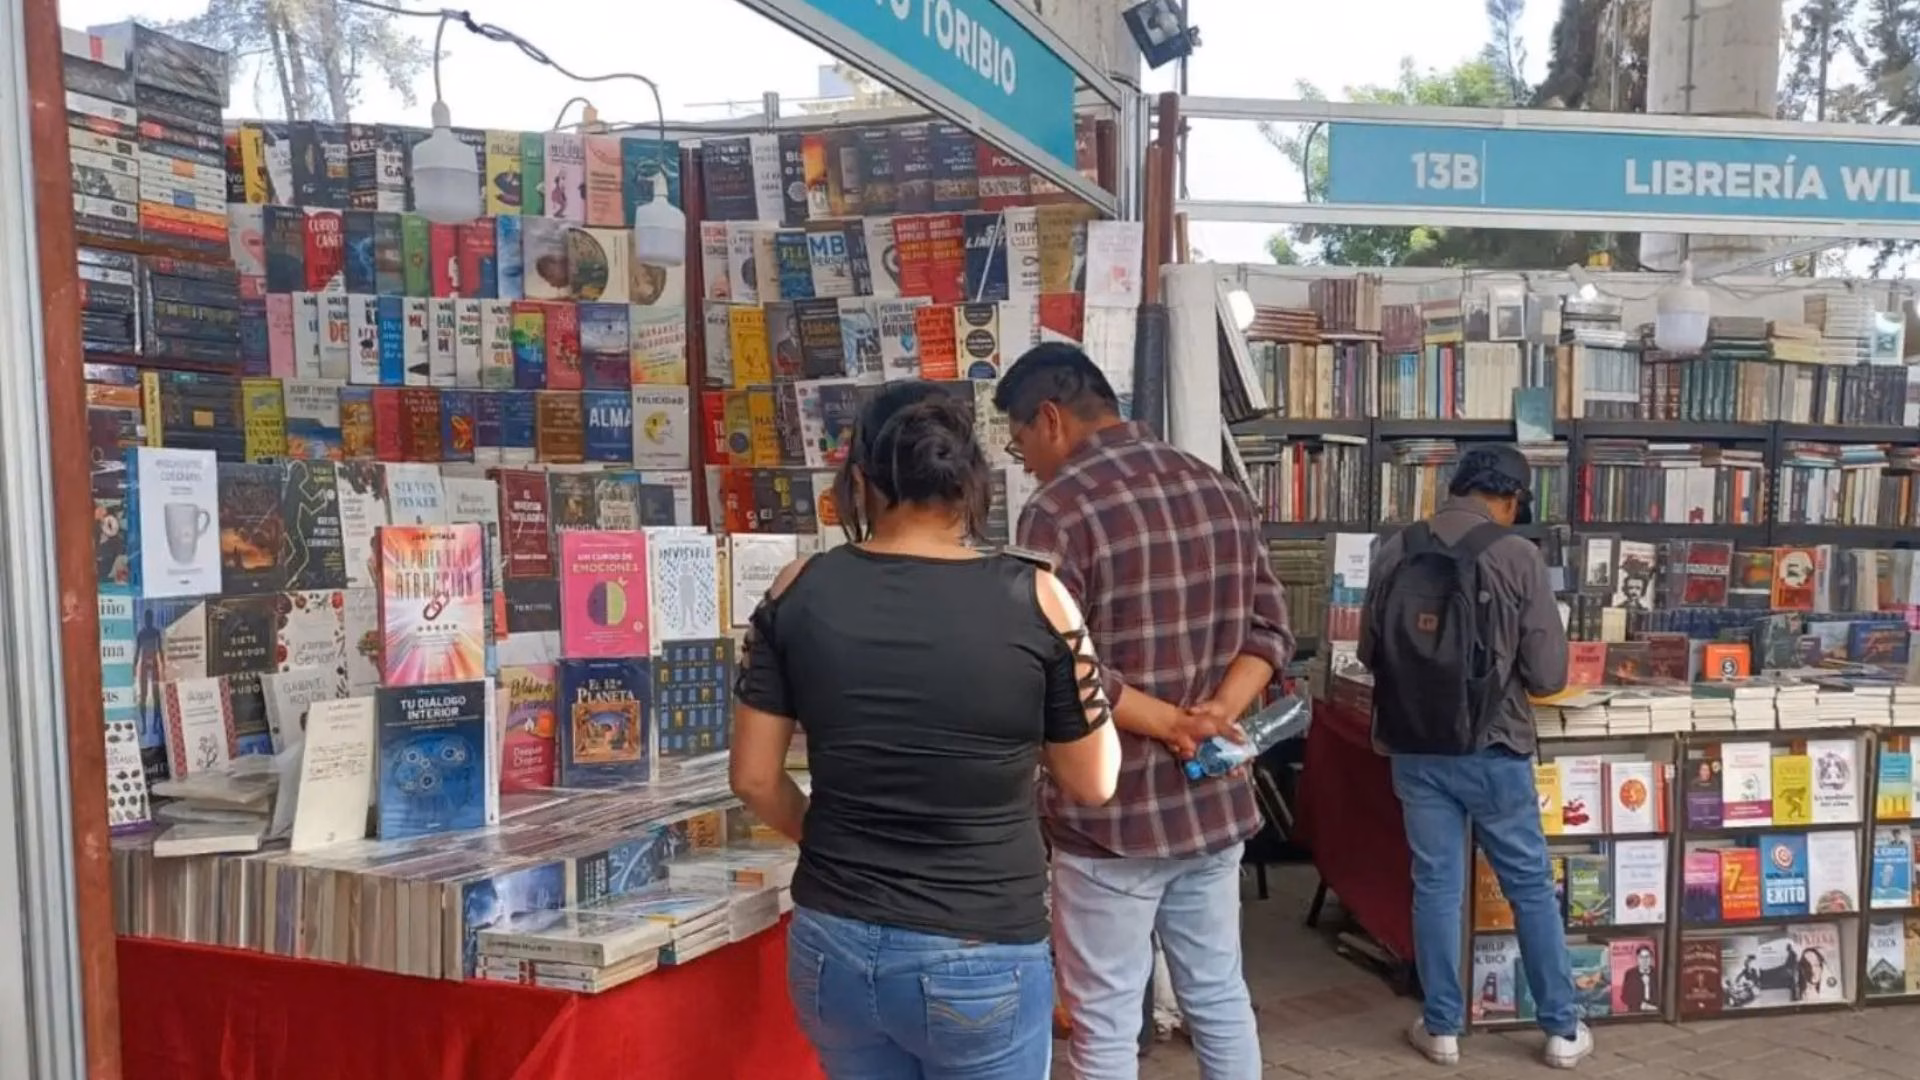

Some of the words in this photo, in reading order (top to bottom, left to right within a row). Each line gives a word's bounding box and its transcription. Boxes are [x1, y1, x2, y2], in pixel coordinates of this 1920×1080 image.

[922, 0, 1016, 96] TORIBIO
[1410, 152, 1478, 191] 13B
[1624, 153, 1825, 199] LIBRERÍA
[1840, 166, 1920, 202] WIL
[589, 408, 632, 428] ALMA
[659, 546, 711, 559] INVISIBLE
[572, 562, 639, 573] EMOCIONES
[223, 648, 266, 658] MARIDOS
[400, 699, 417, 711] TU
[417, 694, 467, 710] DIÁLOGO
[577, 688, 636, 703] PLANETA
[407, 706, 460, 720] INTERIOR
[1725, 862, 1742, 892] 7
